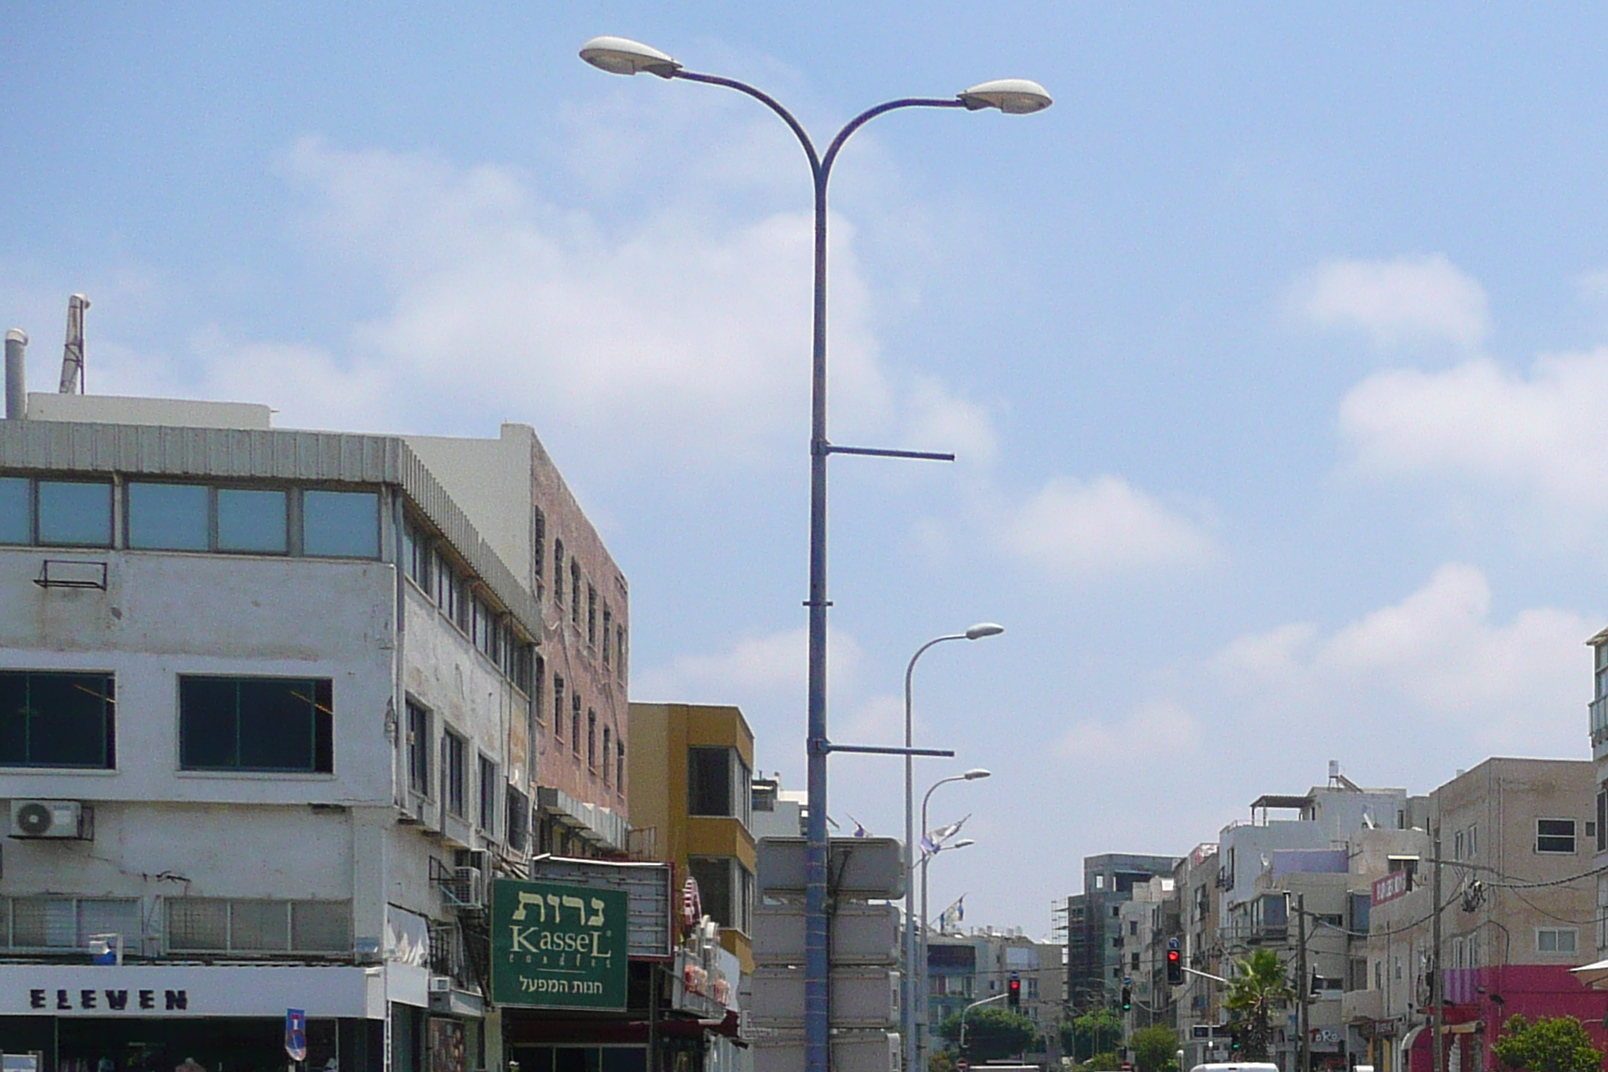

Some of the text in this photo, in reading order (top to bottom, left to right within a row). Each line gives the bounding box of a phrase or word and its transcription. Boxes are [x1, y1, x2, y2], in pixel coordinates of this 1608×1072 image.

[512, 891, 605, 926] נרות
[519, 975, 603, 995] חנות המפעל
[30, 989, 187, 1010] ELEVEN
